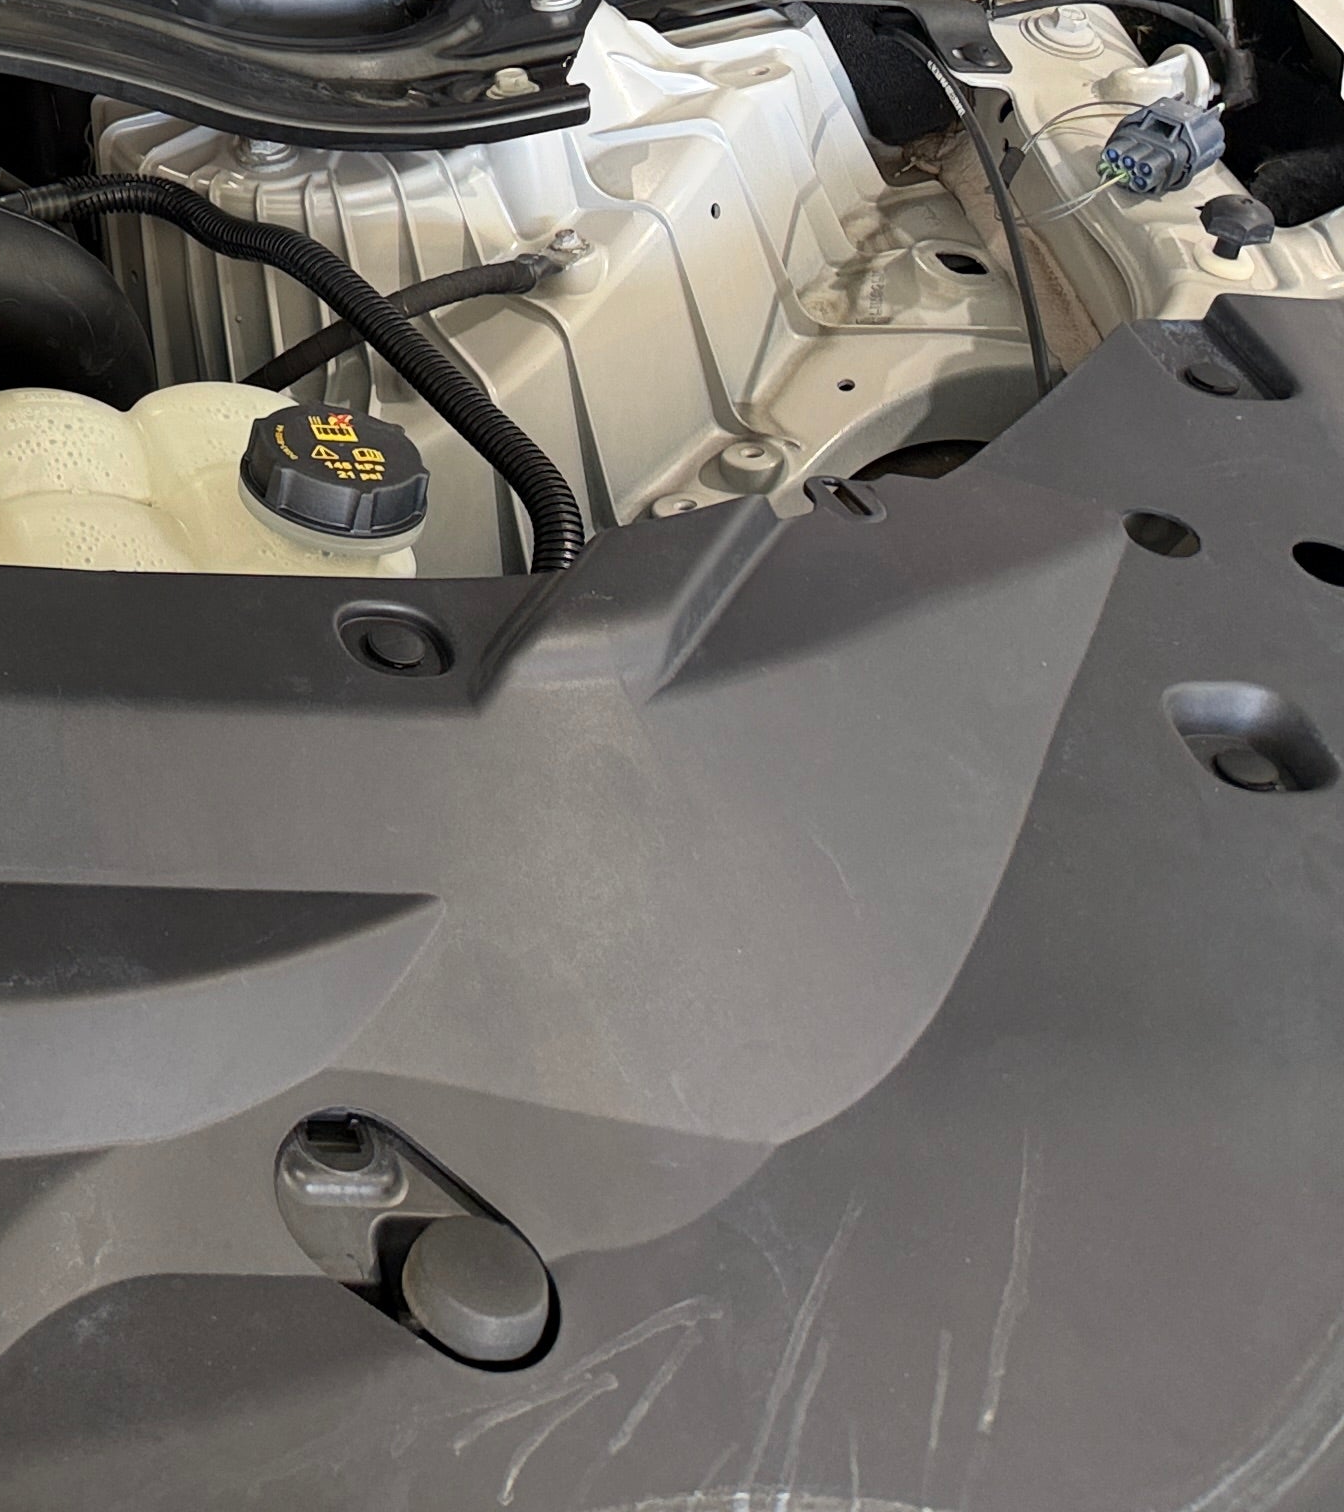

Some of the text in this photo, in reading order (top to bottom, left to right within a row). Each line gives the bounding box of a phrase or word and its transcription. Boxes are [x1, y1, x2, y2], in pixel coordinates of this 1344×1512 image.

[355, 462, 385, 472] kPa
[337, 471, 383, 481] 21 psi
